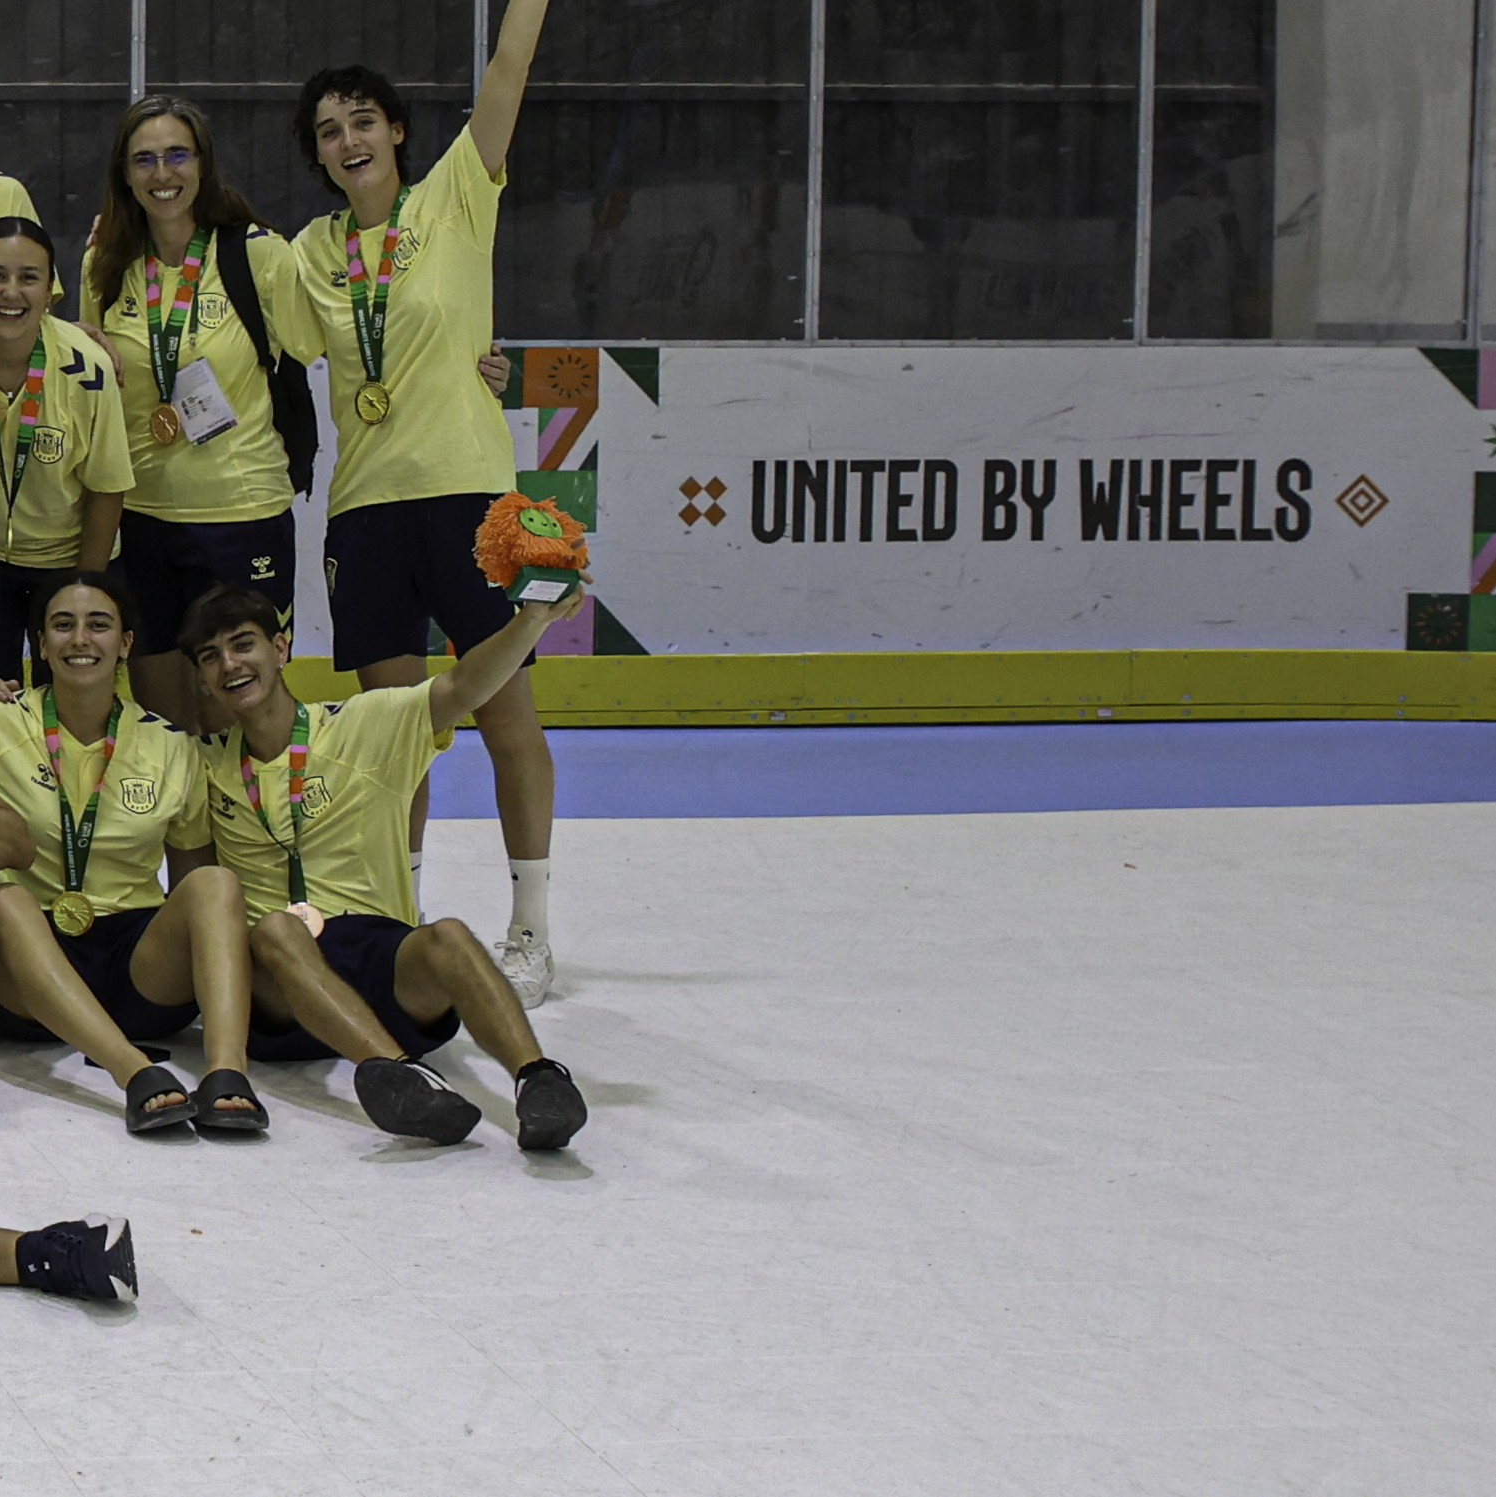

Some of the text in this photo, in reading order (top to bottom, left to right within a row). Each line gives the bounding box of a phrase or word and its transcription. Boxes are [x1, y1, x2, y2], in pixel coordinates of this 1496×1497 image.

[751, 458, 1313, 545] UNITED BY WHEELS
